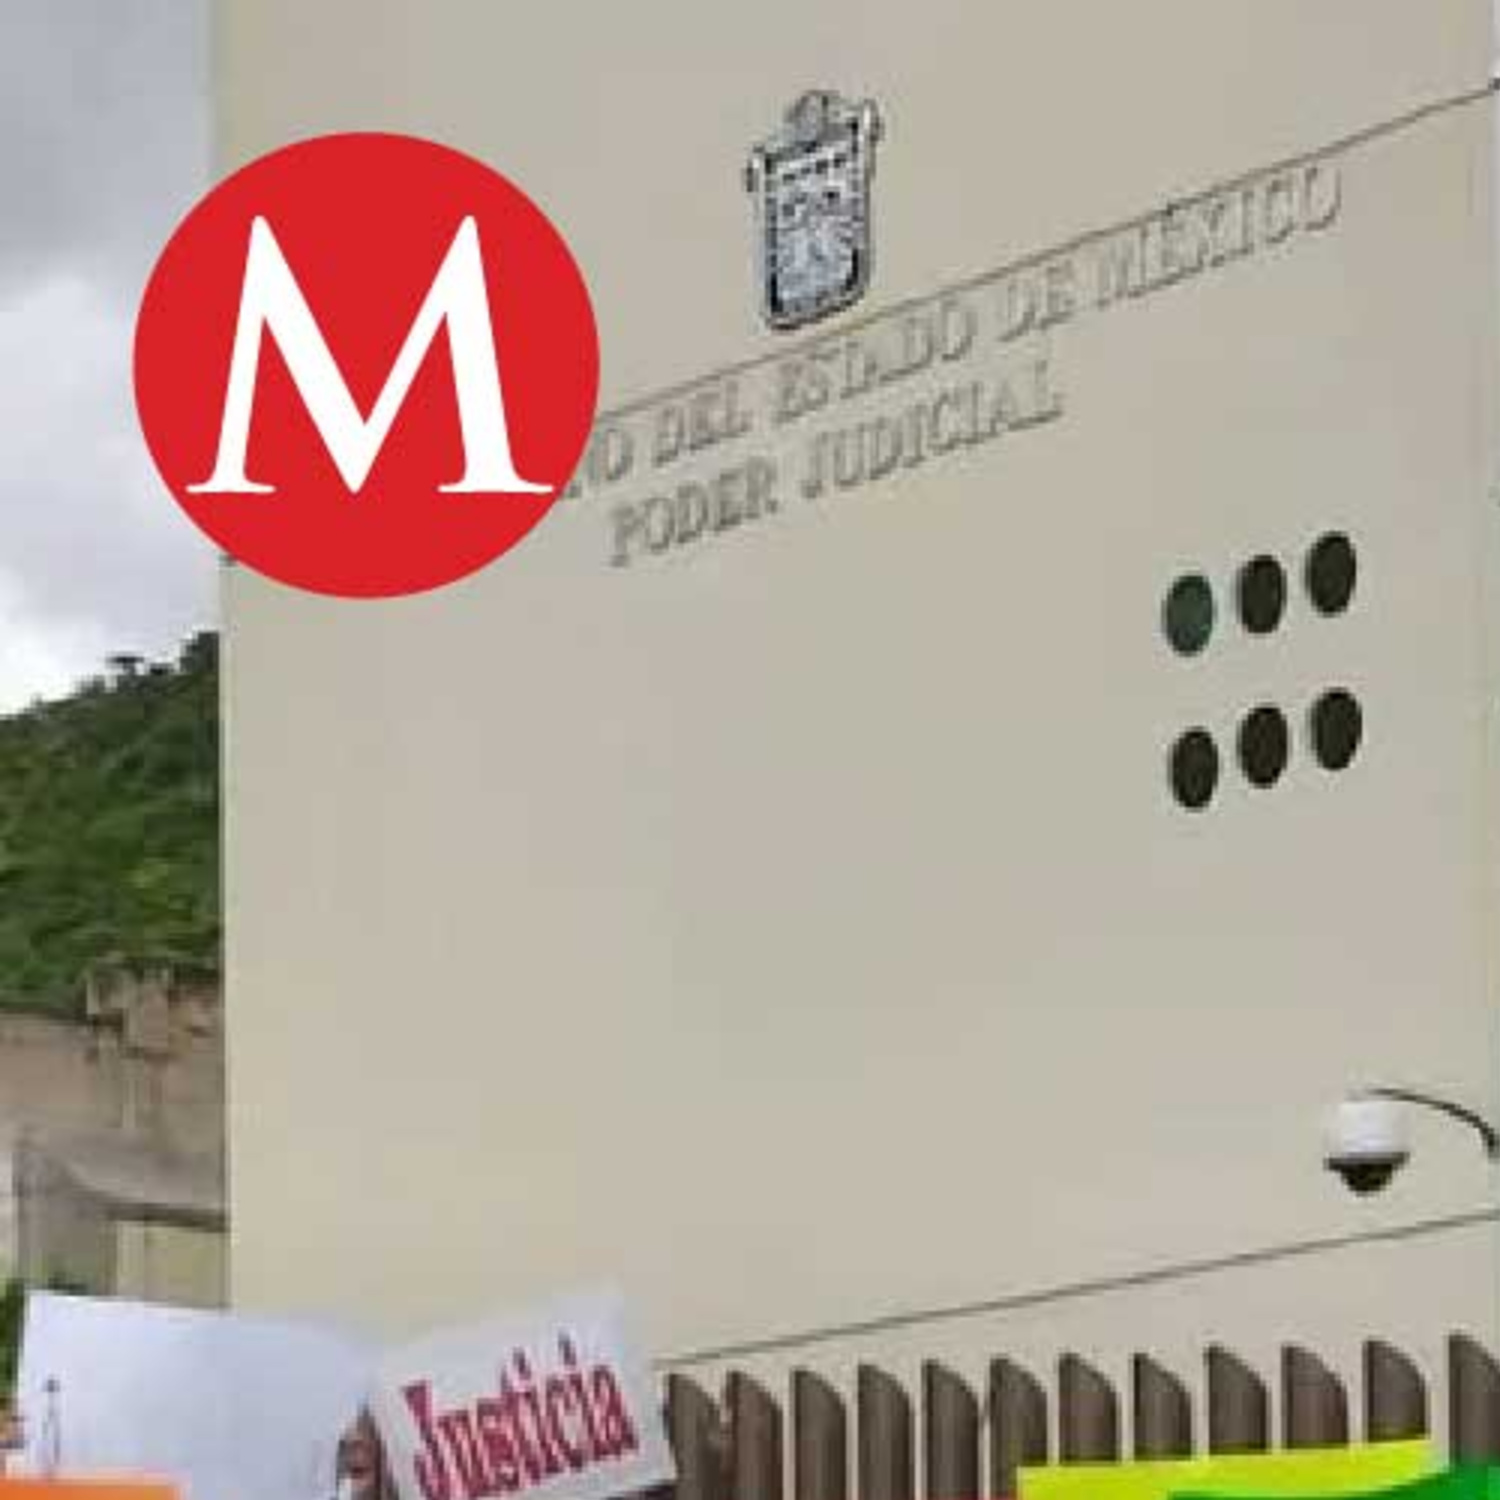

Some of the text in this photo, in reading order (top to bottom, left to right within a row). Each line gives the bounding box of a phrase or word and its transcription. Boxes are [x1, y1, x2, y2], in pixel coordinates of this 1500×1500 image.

[609, 456, 779, 567] PODER
[804, 357, 1065, 499] JUDICIAL
[655, 380, 753, 464] DEL
[1001, 276, 1076, 343] DE
